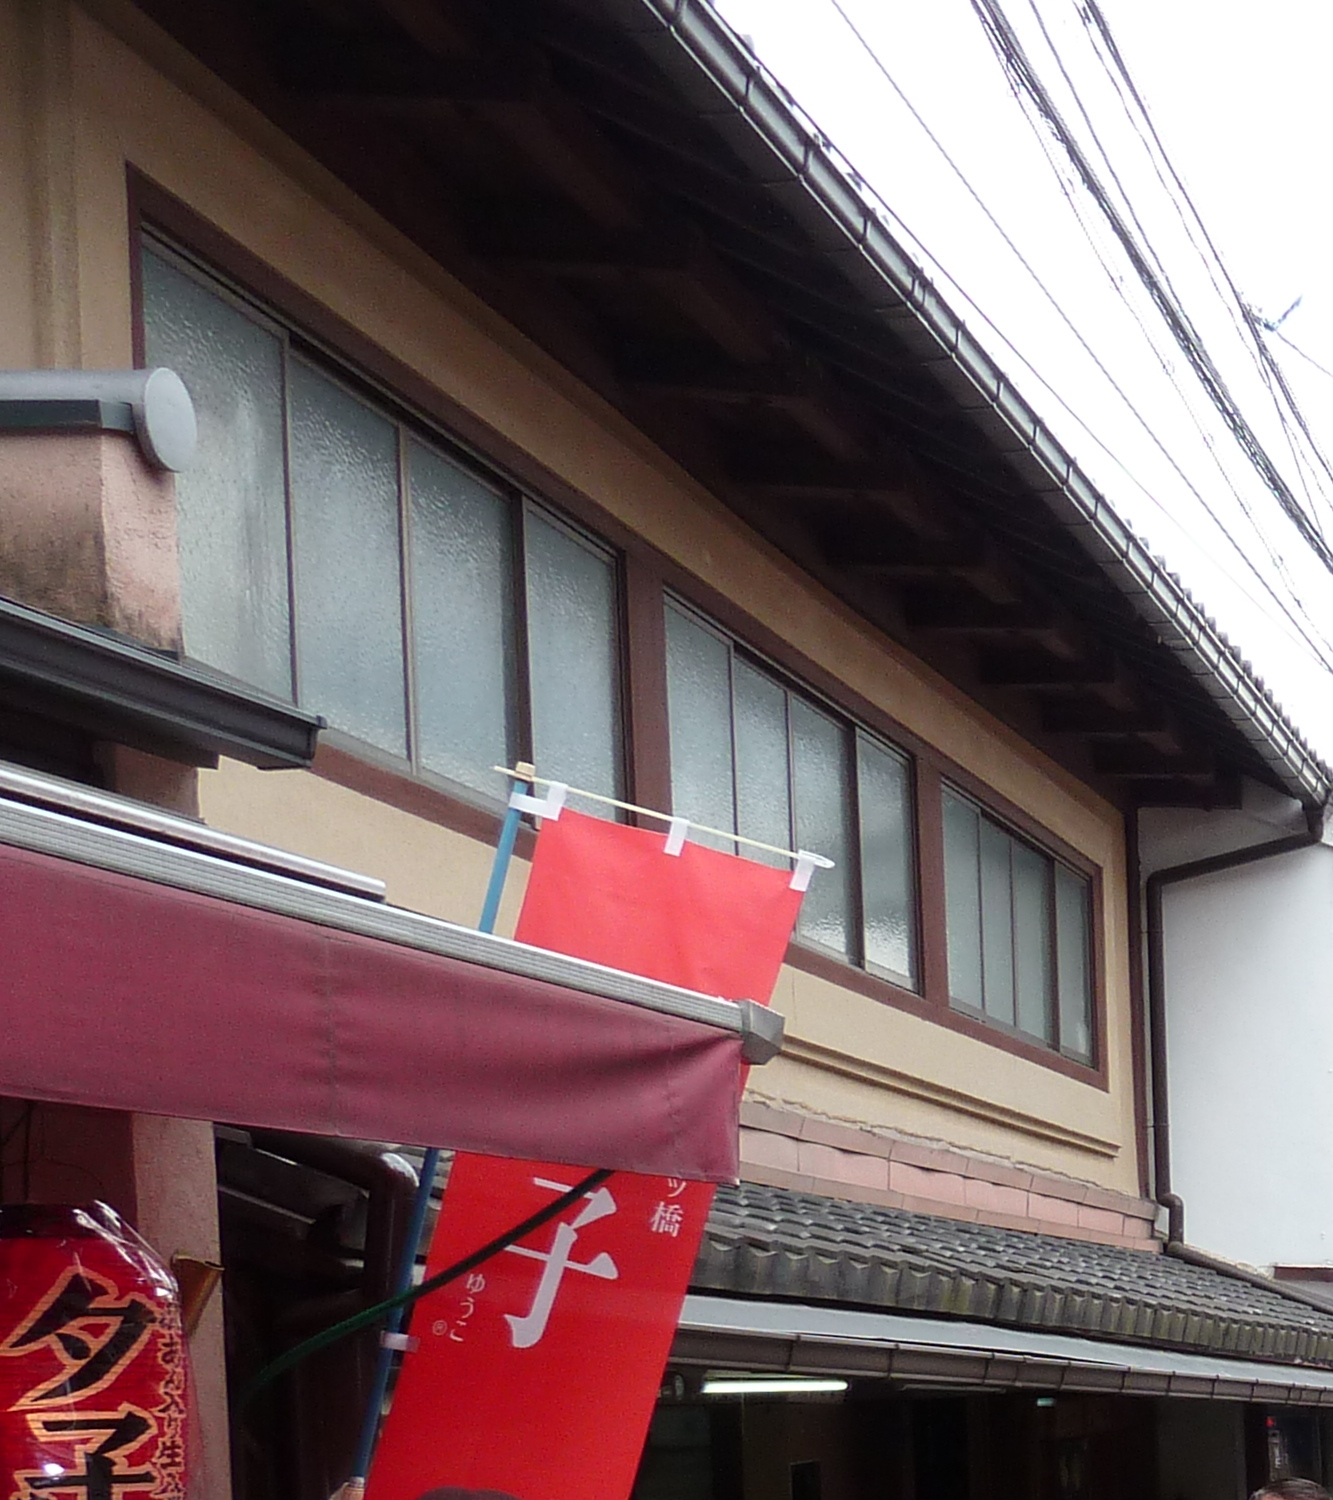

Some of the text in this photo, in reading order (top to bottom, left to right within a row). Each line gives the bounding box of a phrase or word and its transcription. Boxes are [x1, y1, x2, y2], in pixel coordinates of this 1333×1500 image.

[449, 1272, 486, 1342] ゆうこ
[503, 1175, 620, 1349] 子
